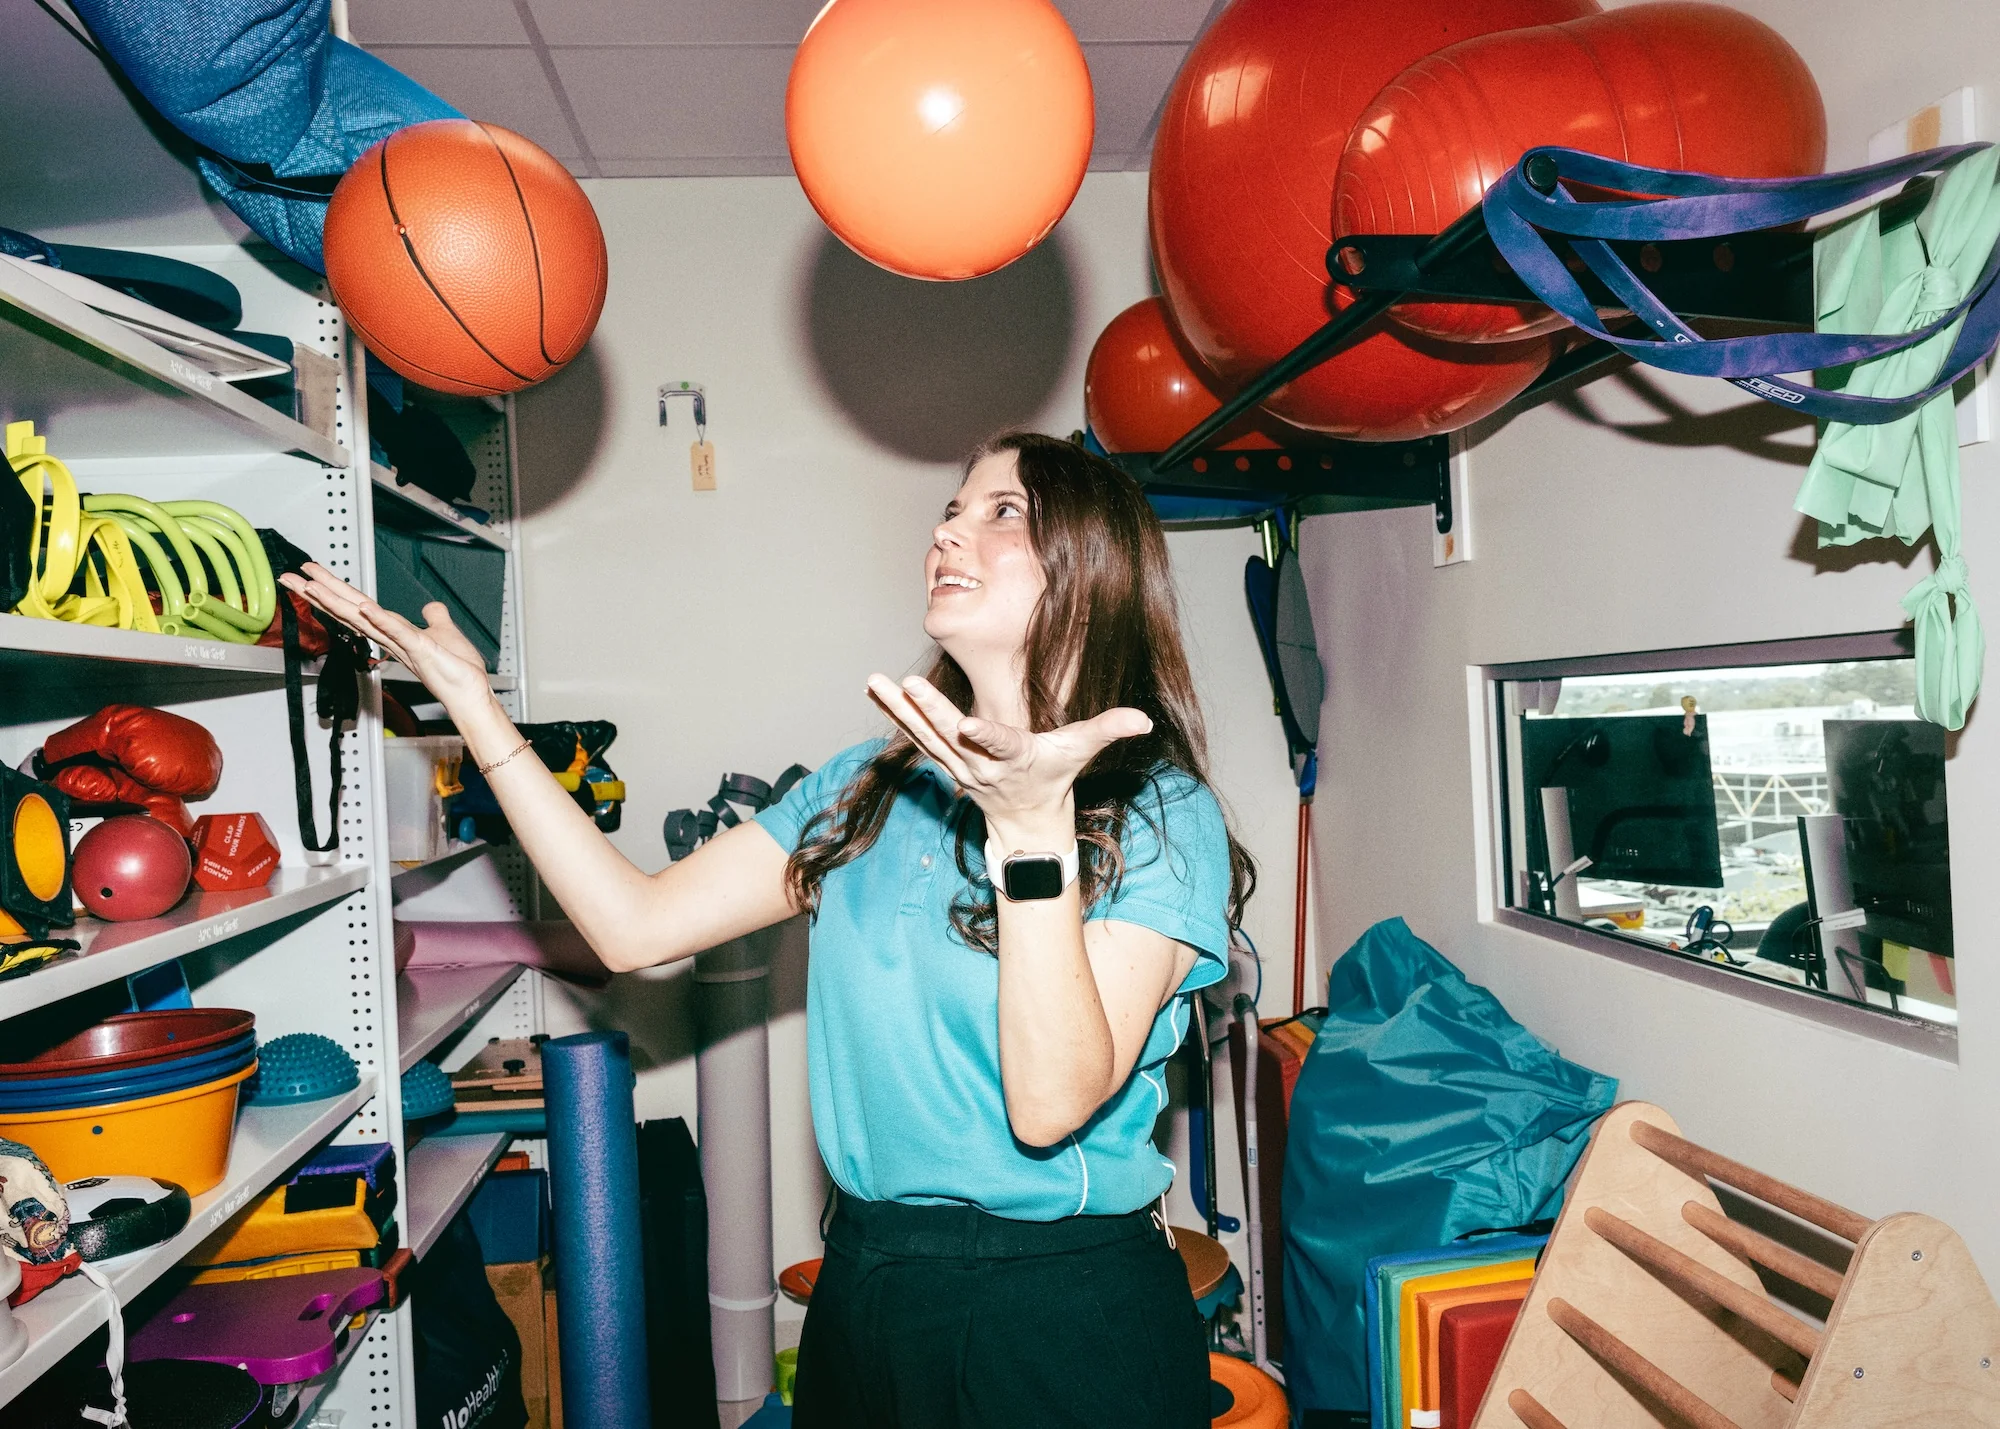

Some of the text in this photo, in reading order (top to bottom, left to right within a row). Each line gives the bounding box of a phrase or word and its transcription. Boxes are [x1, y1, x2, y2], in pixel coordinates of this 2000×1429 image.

[224, 825, 234, 844] CLAP
[229, 815, 247, 857] YOUR HANDS
[203, 865, 229, 881] HANDS
[204, 858, 233, 876] ON HIPS
[247, 856, 271, 877] FREEZE
